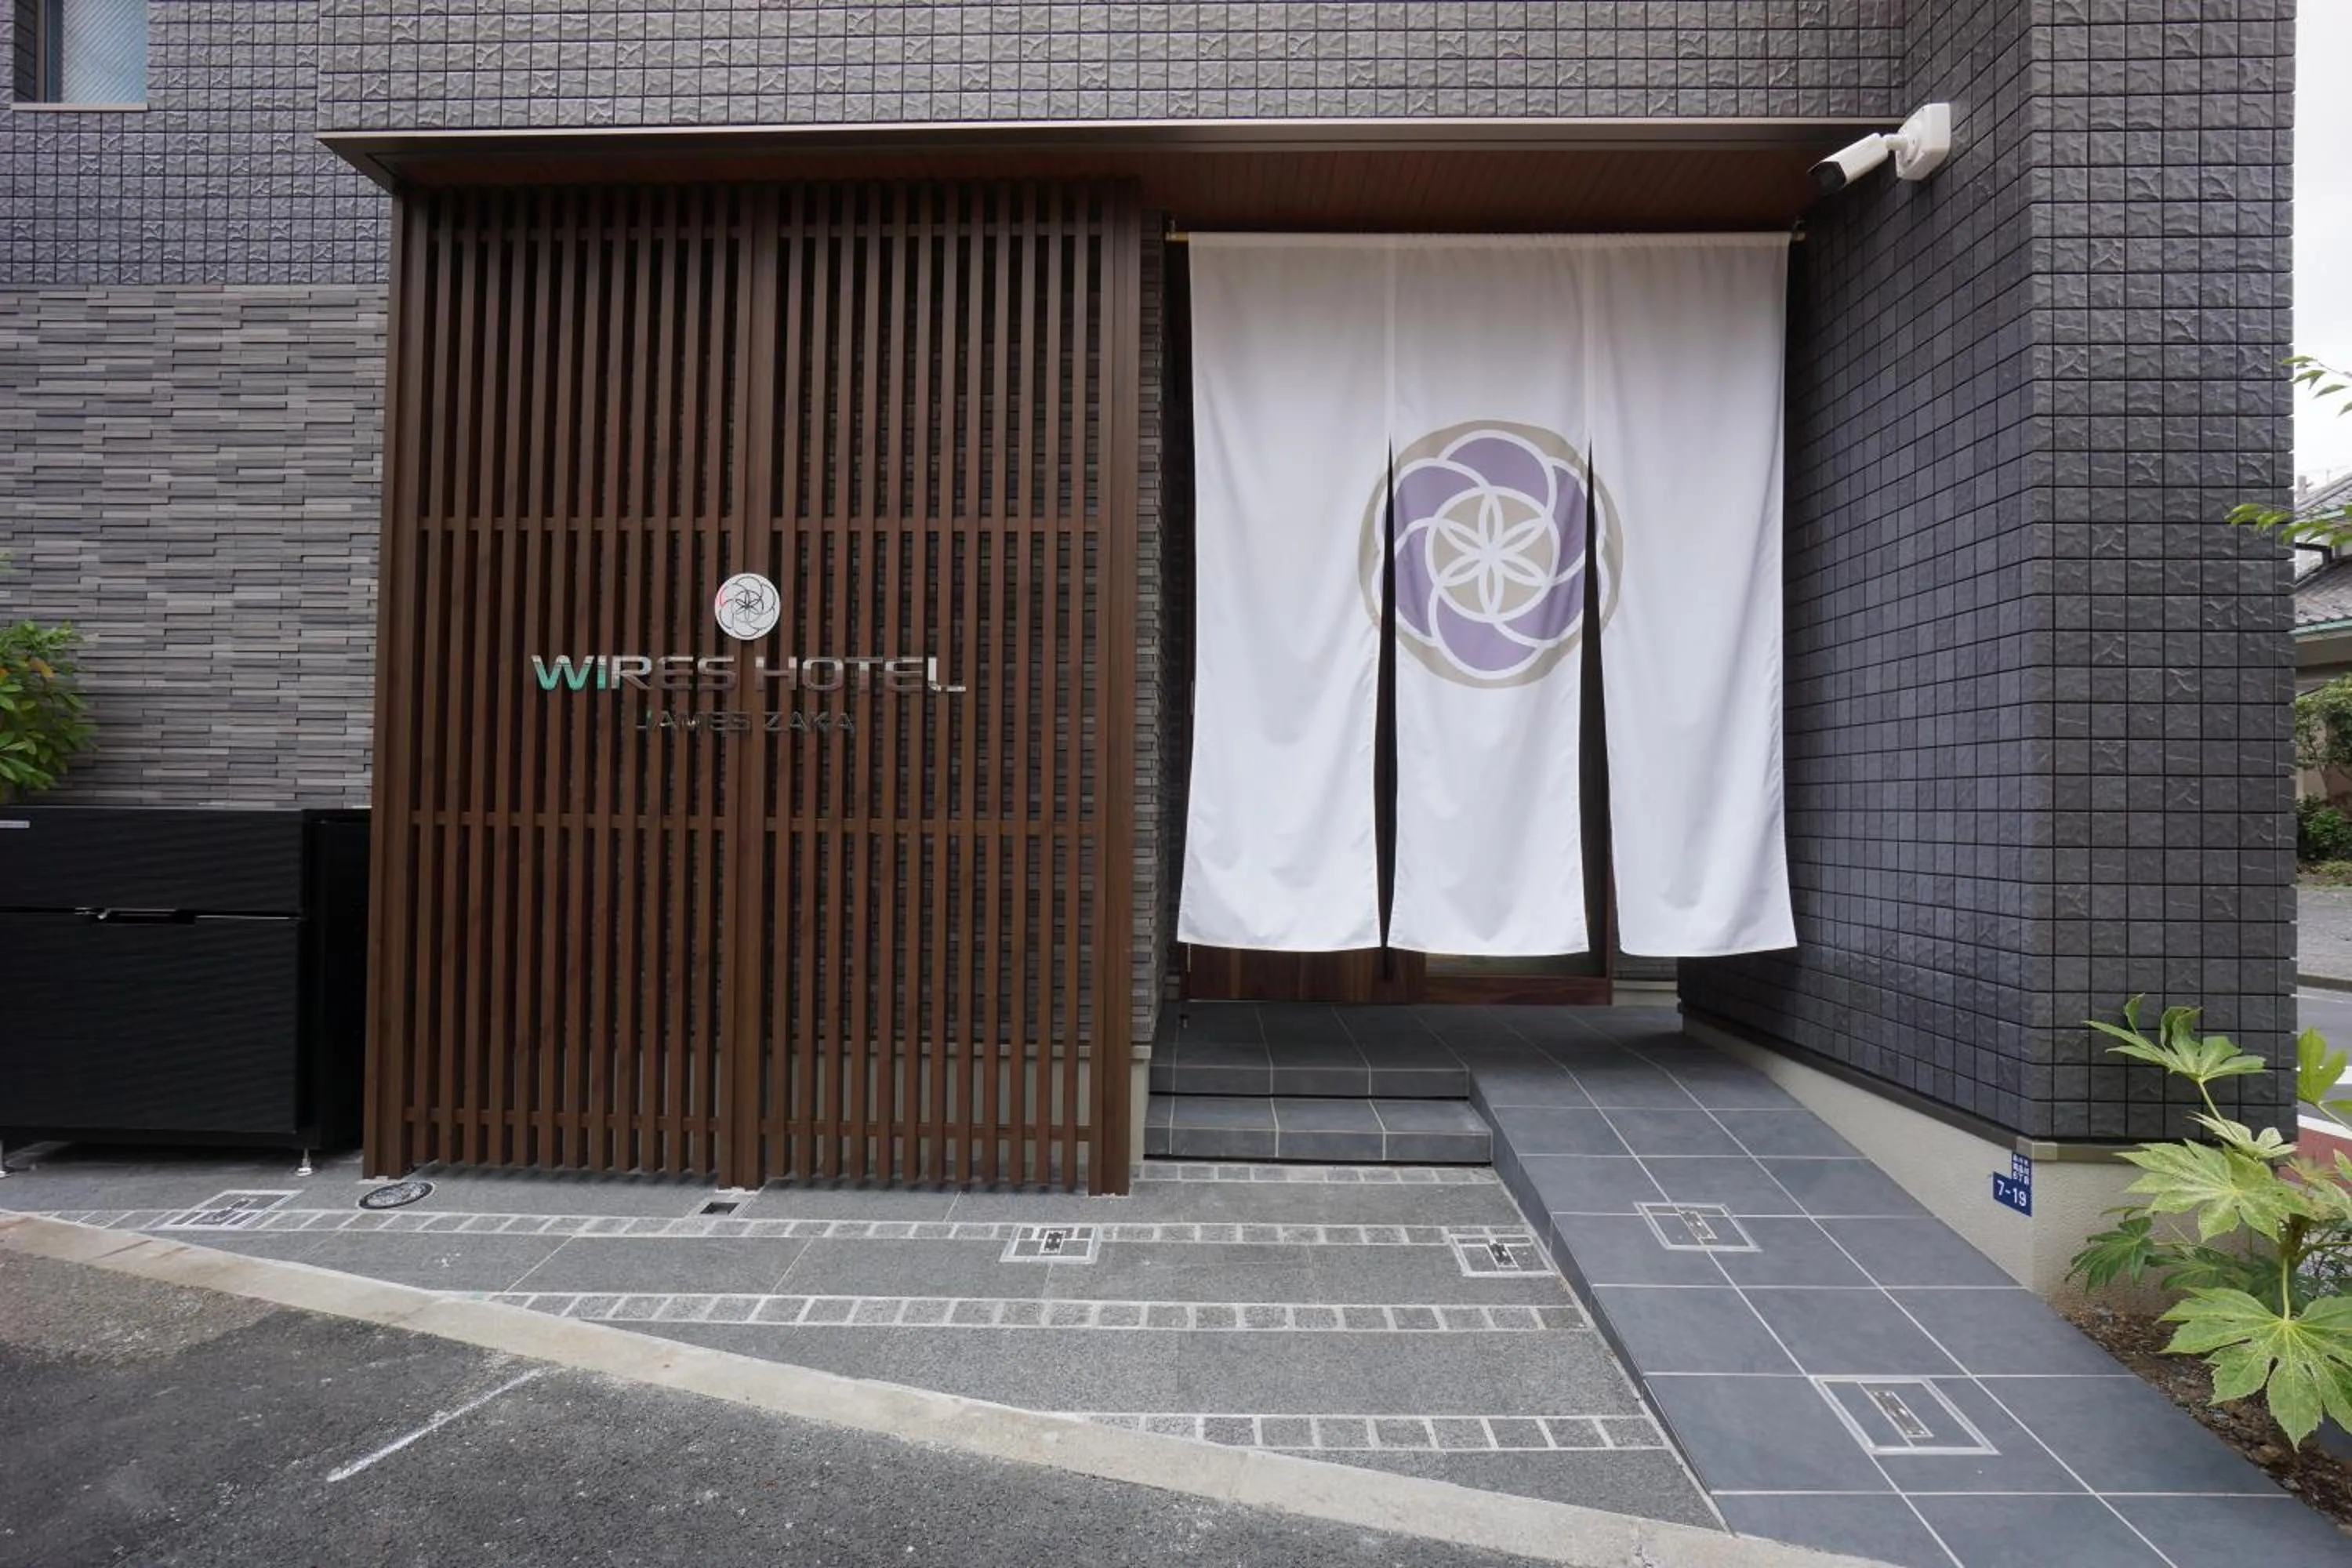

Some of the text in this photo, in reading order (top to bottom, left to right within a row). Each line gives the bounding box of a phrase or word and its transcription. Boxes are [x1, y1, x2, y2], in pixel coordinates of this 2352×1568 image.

[531, 655, 967, 692] WIRES HOTEL
[636, 710, 855, 732] JAMES ZAKA
[1997, 1179, 2027, 1207] 7-19
